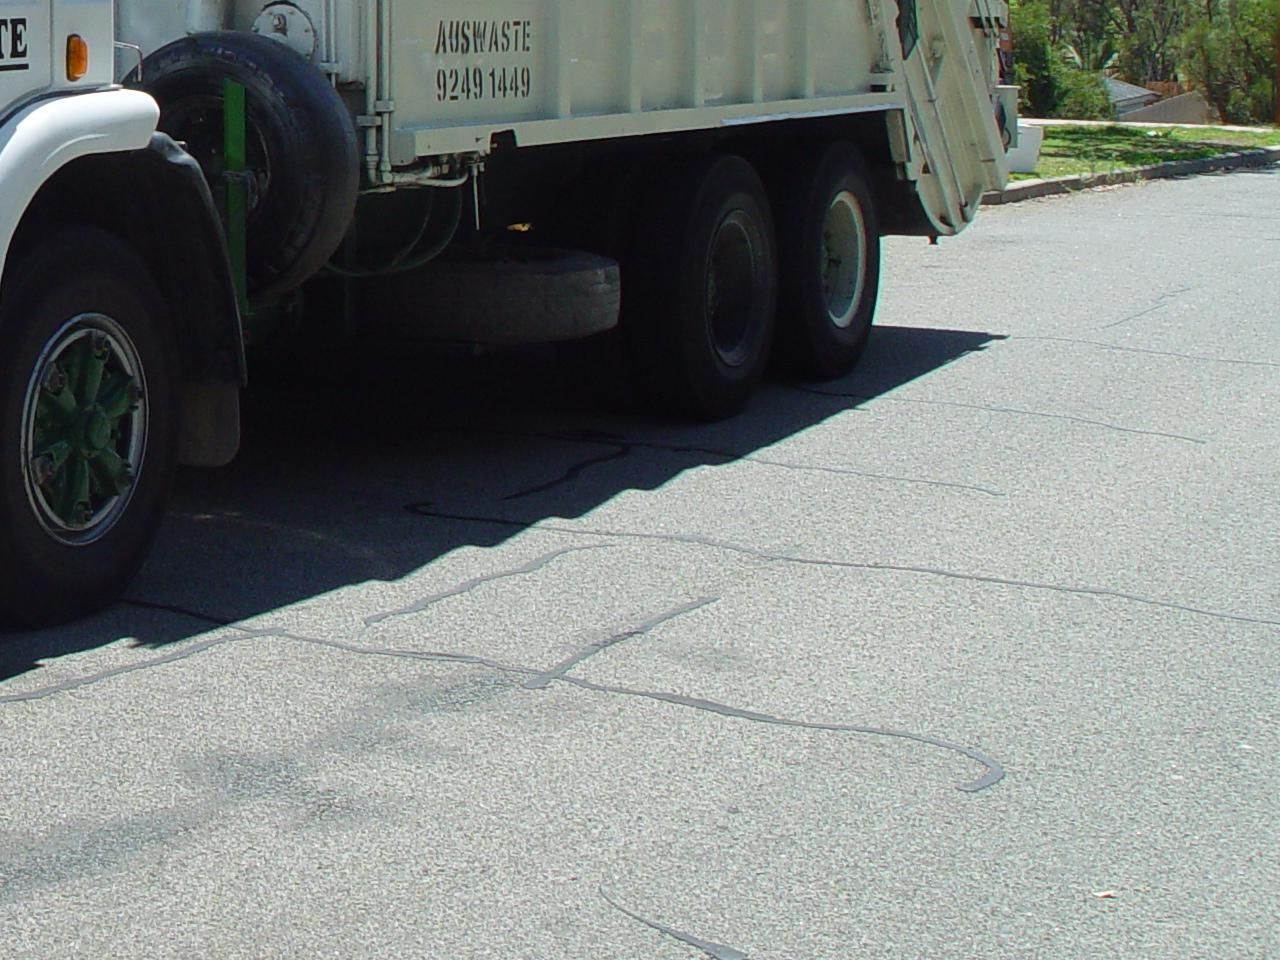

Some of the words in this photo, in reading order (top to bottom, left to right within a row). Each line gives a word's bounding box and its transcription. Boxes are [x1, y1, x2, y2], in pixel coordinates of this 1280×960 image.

[435, 20, 531, 55] AUSWASTE
[437, 67, 483, 101] 9249
[489, 66, 531, 99] 1449
